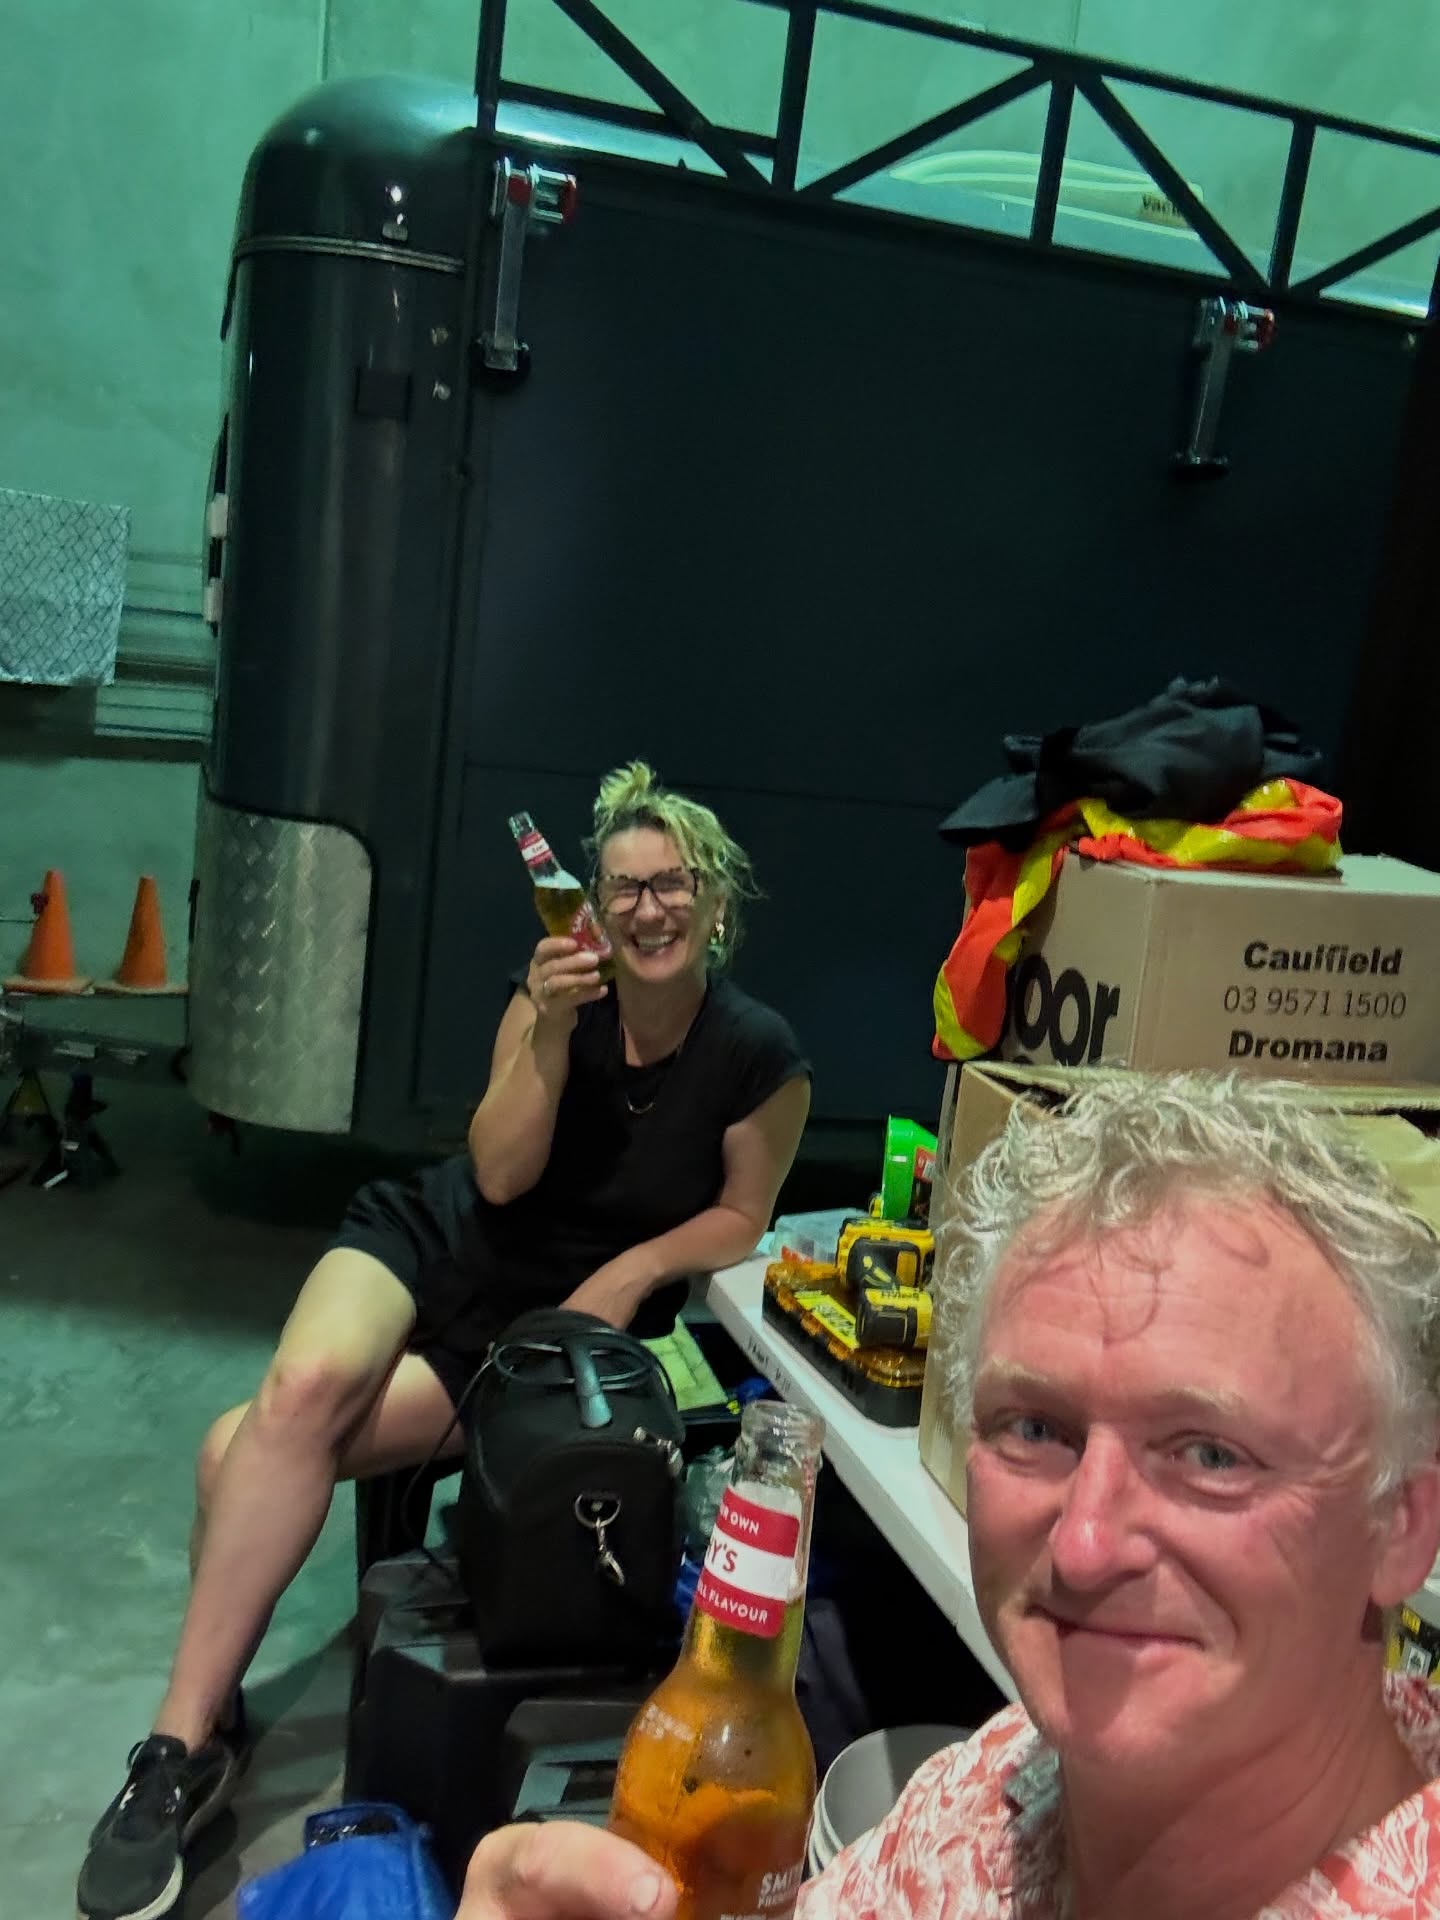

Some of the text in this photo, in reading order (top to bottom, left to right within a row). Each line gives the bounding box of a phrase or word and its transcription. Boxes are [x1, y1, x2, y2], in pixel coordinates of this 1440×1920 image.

[1243, 939, 1403, 976] Caulfield
[1223, 985, 1407, 1019] 03 9571 1500
[1228, 1029, 1389, 1063] Dromana
[730, 1511, 760, 1535] OWN
[708, 1592, 768, 1624] FLAVOUR
